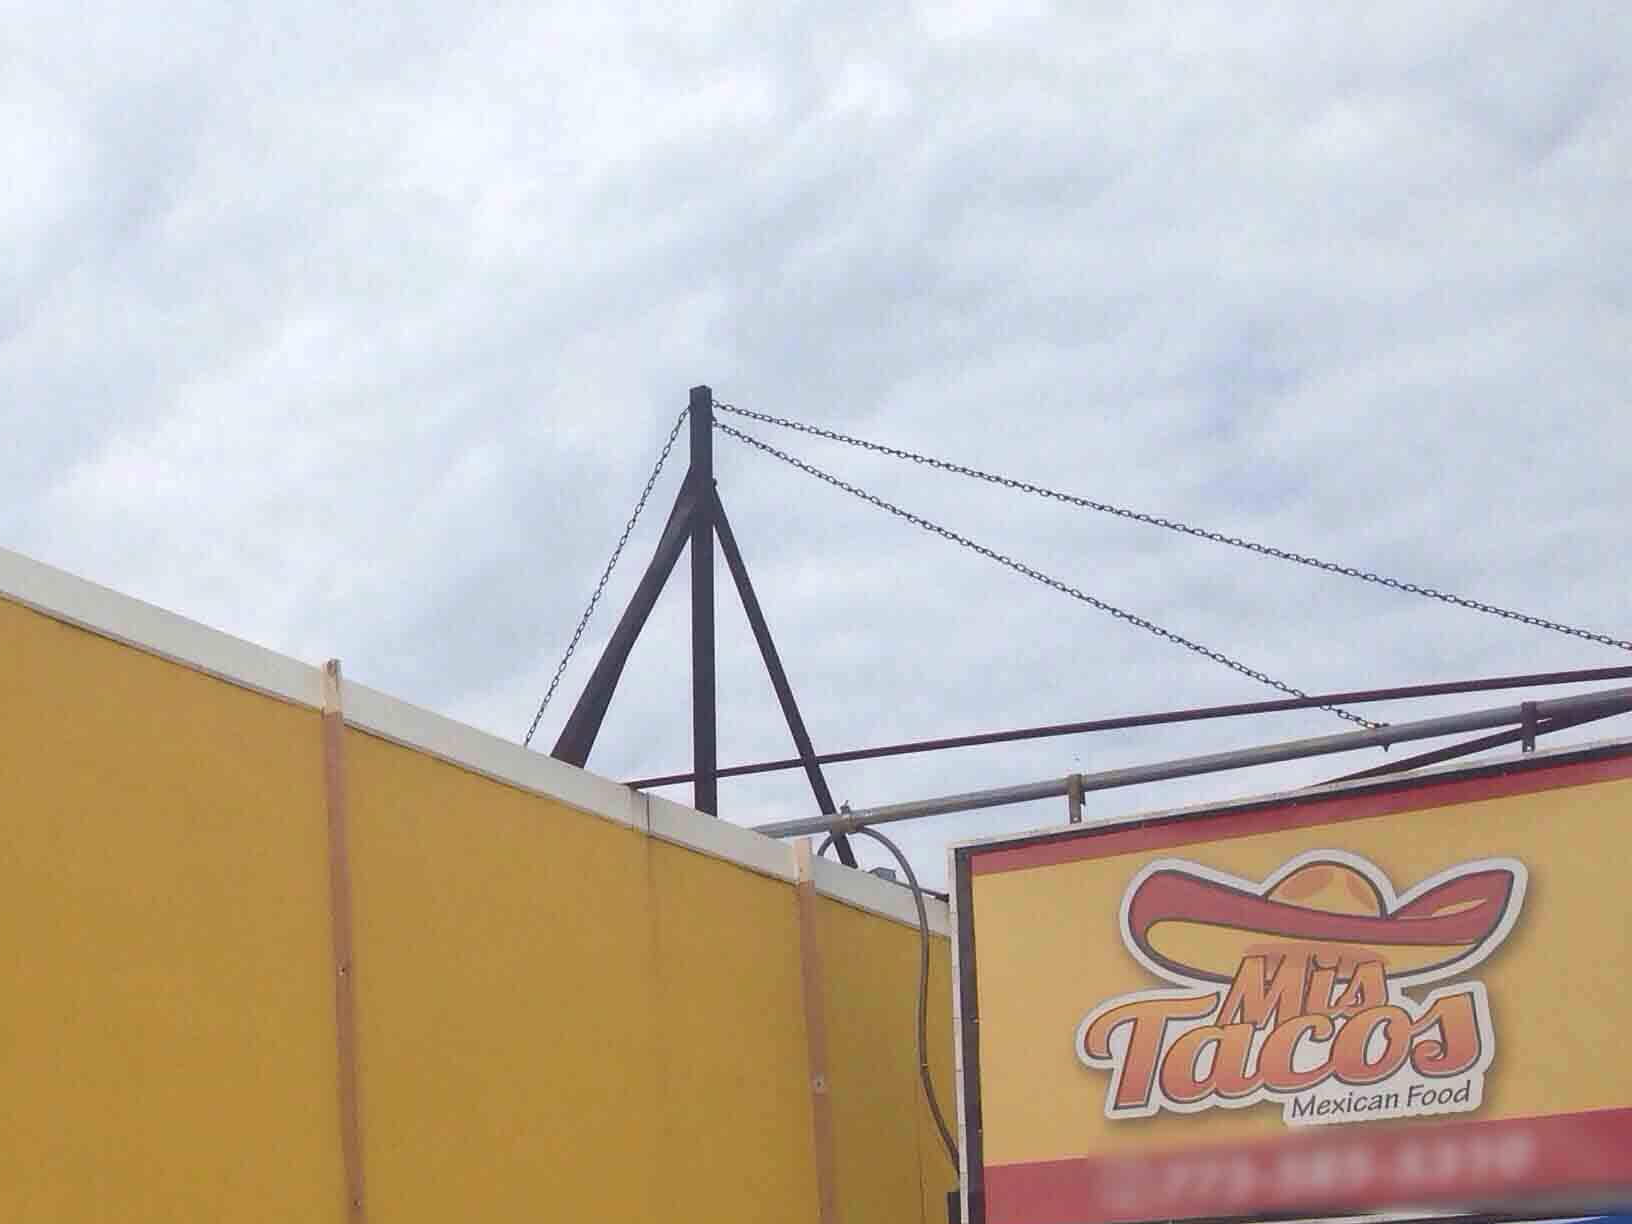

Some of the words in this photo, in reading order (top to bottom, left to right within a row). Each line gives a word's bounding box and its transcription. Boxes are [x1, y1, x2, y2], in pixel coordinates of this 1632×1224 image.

[1216, 955, 1390, 1026] Mis
[1085, 990, 1482, 1110] Tacos
[1291, 1091, 1400, 1119] Mexican
[1406, 1080, 1472, 1108] Food
